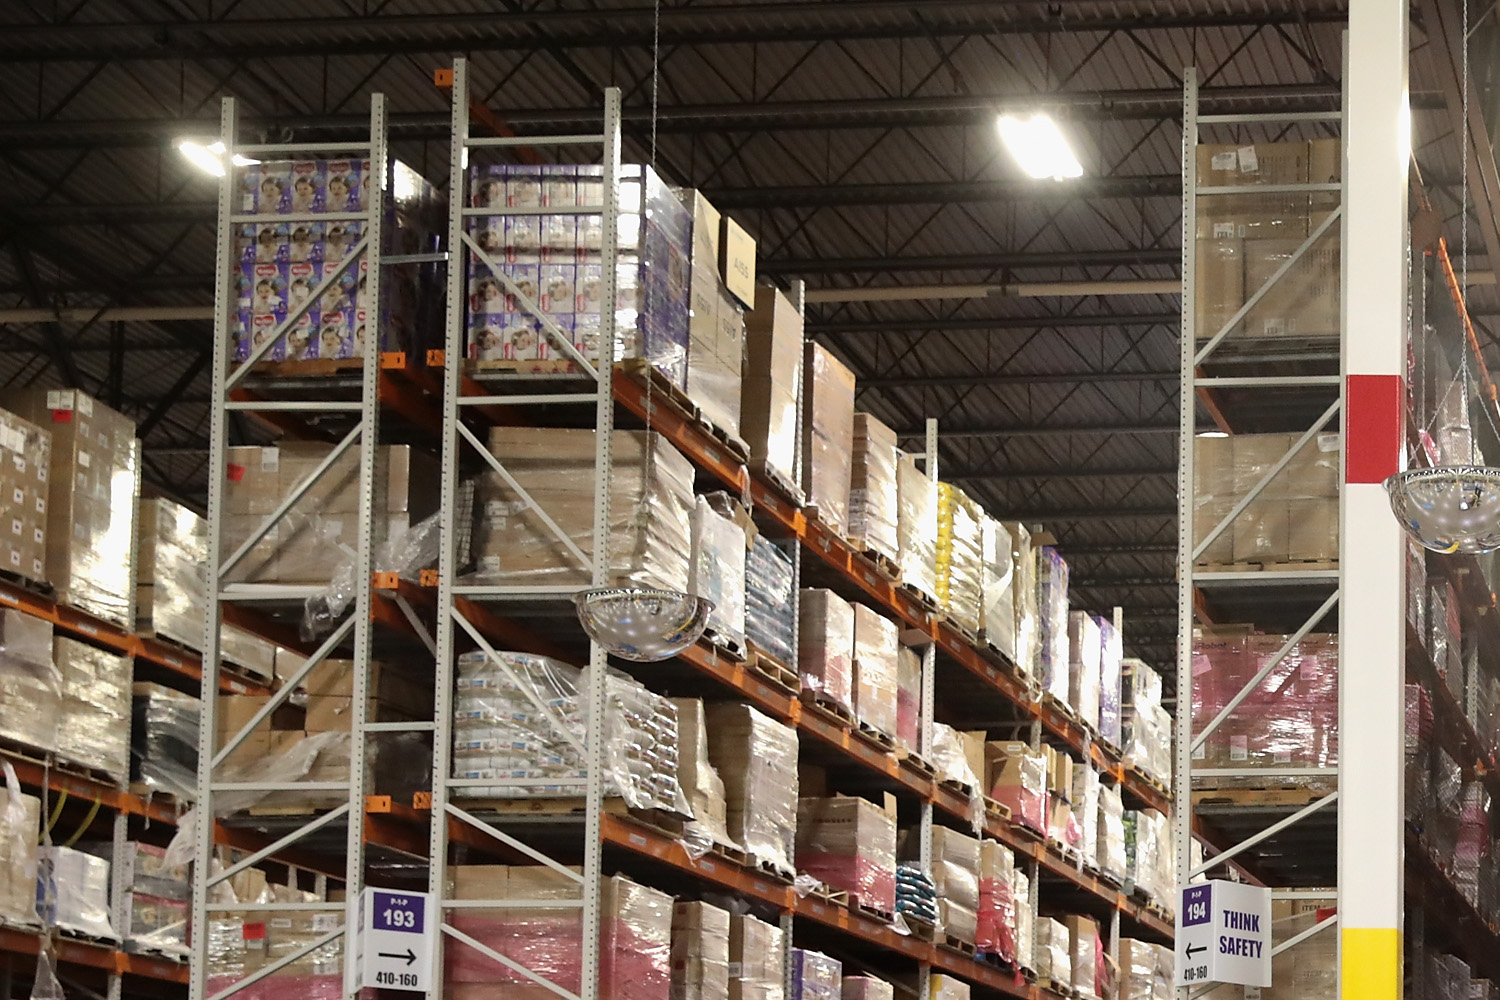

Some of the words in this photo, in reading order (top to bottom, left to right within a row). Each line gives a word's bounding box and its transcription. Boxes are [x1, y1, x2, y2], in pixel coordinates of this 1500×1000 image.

[383, 909, 415, 928] 193
[1187, 901, 1206, 920] 194
[1223, 910, 1260, 932] THINK
[1219, 935, 1263, 959] SAFETY
[376, 971, 418, 987] 410-160
[1183, 965, 1208, 981] 410-160
